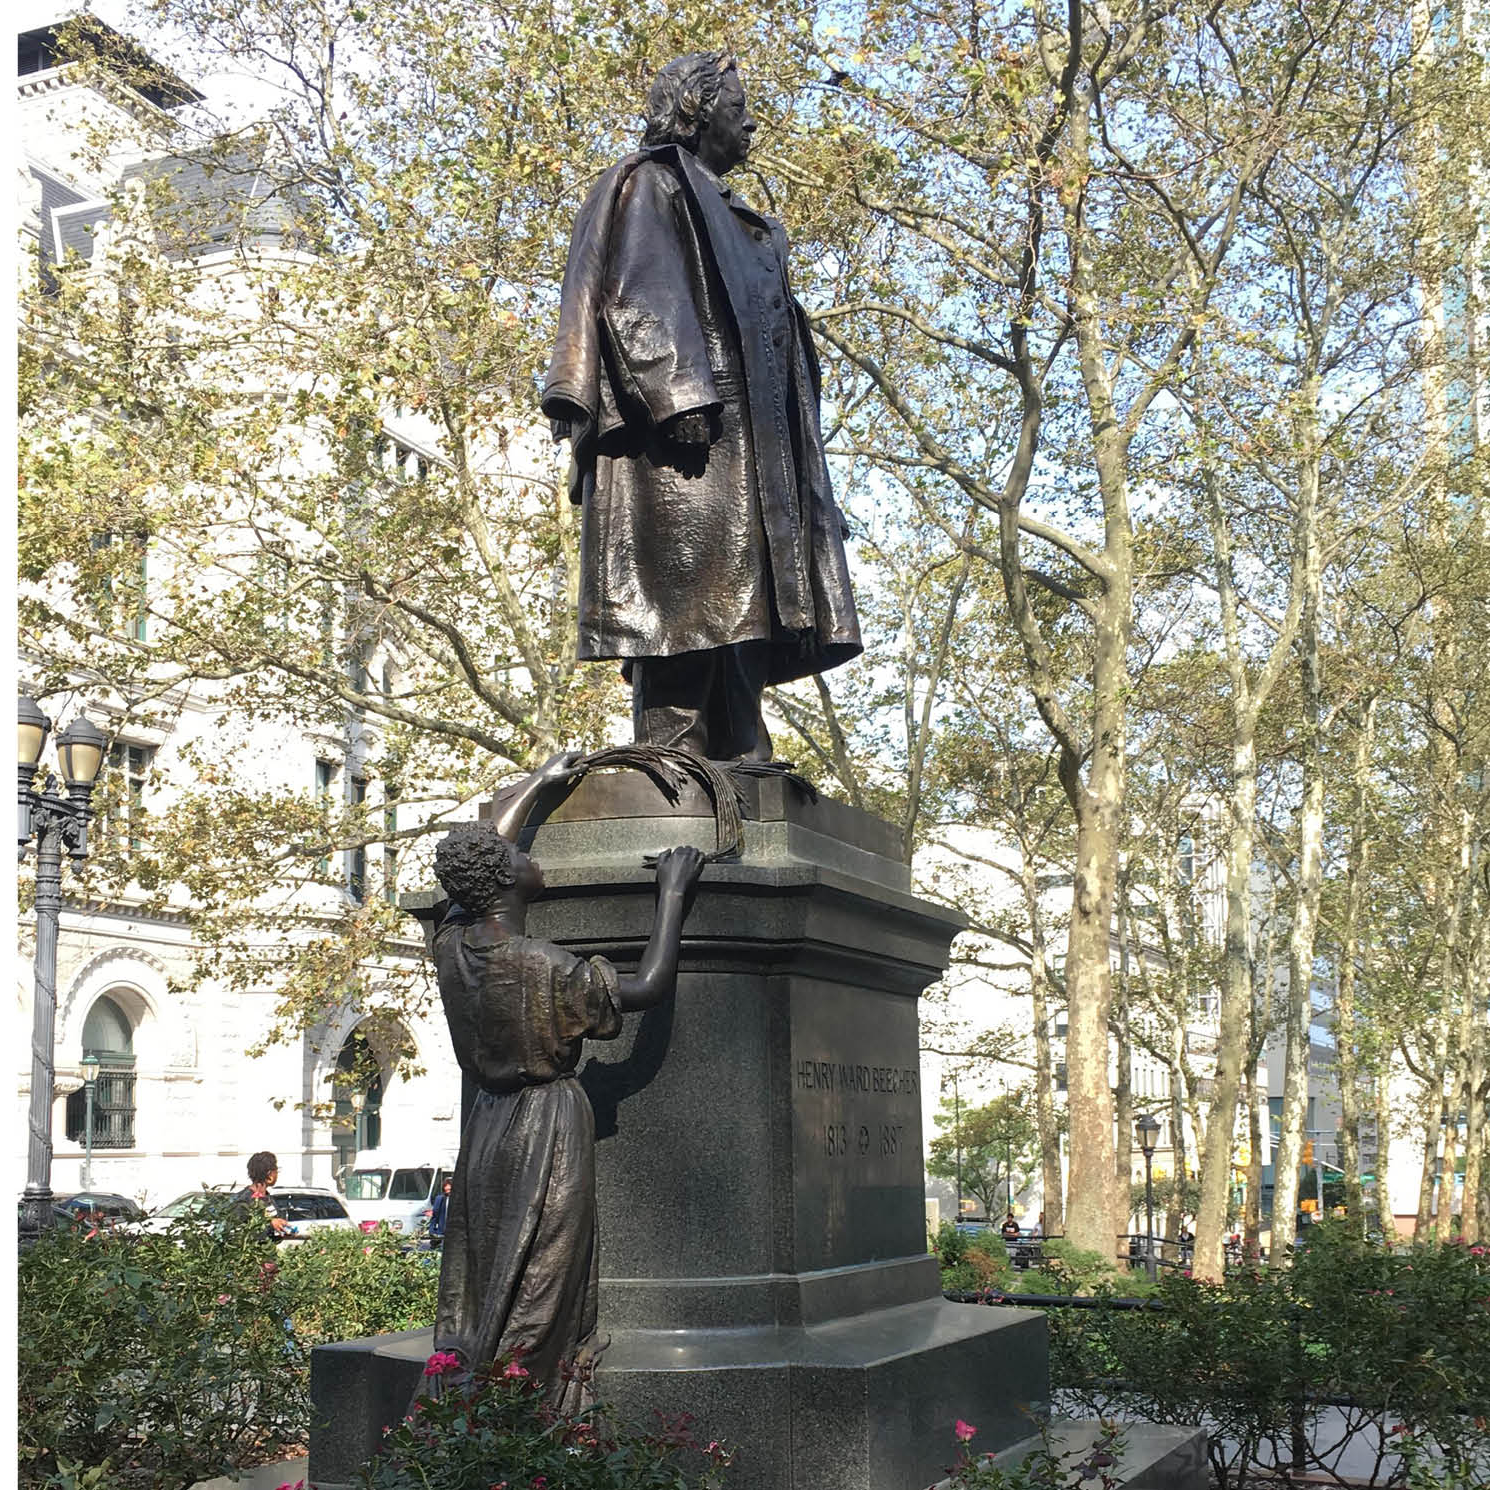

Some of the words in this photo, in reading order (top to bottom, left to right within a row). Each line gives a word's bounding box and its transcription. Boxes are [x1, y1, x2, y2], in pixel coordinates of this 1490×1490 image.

[796, 1060, 836, 1092] HENRY
[838, 1064, 871, 1093] WARD
[873, 1067, 918, 1095] BEECHER
[823, 1125, 847, 1157] 1813
[879, 1125, 903, 1158] 1887
